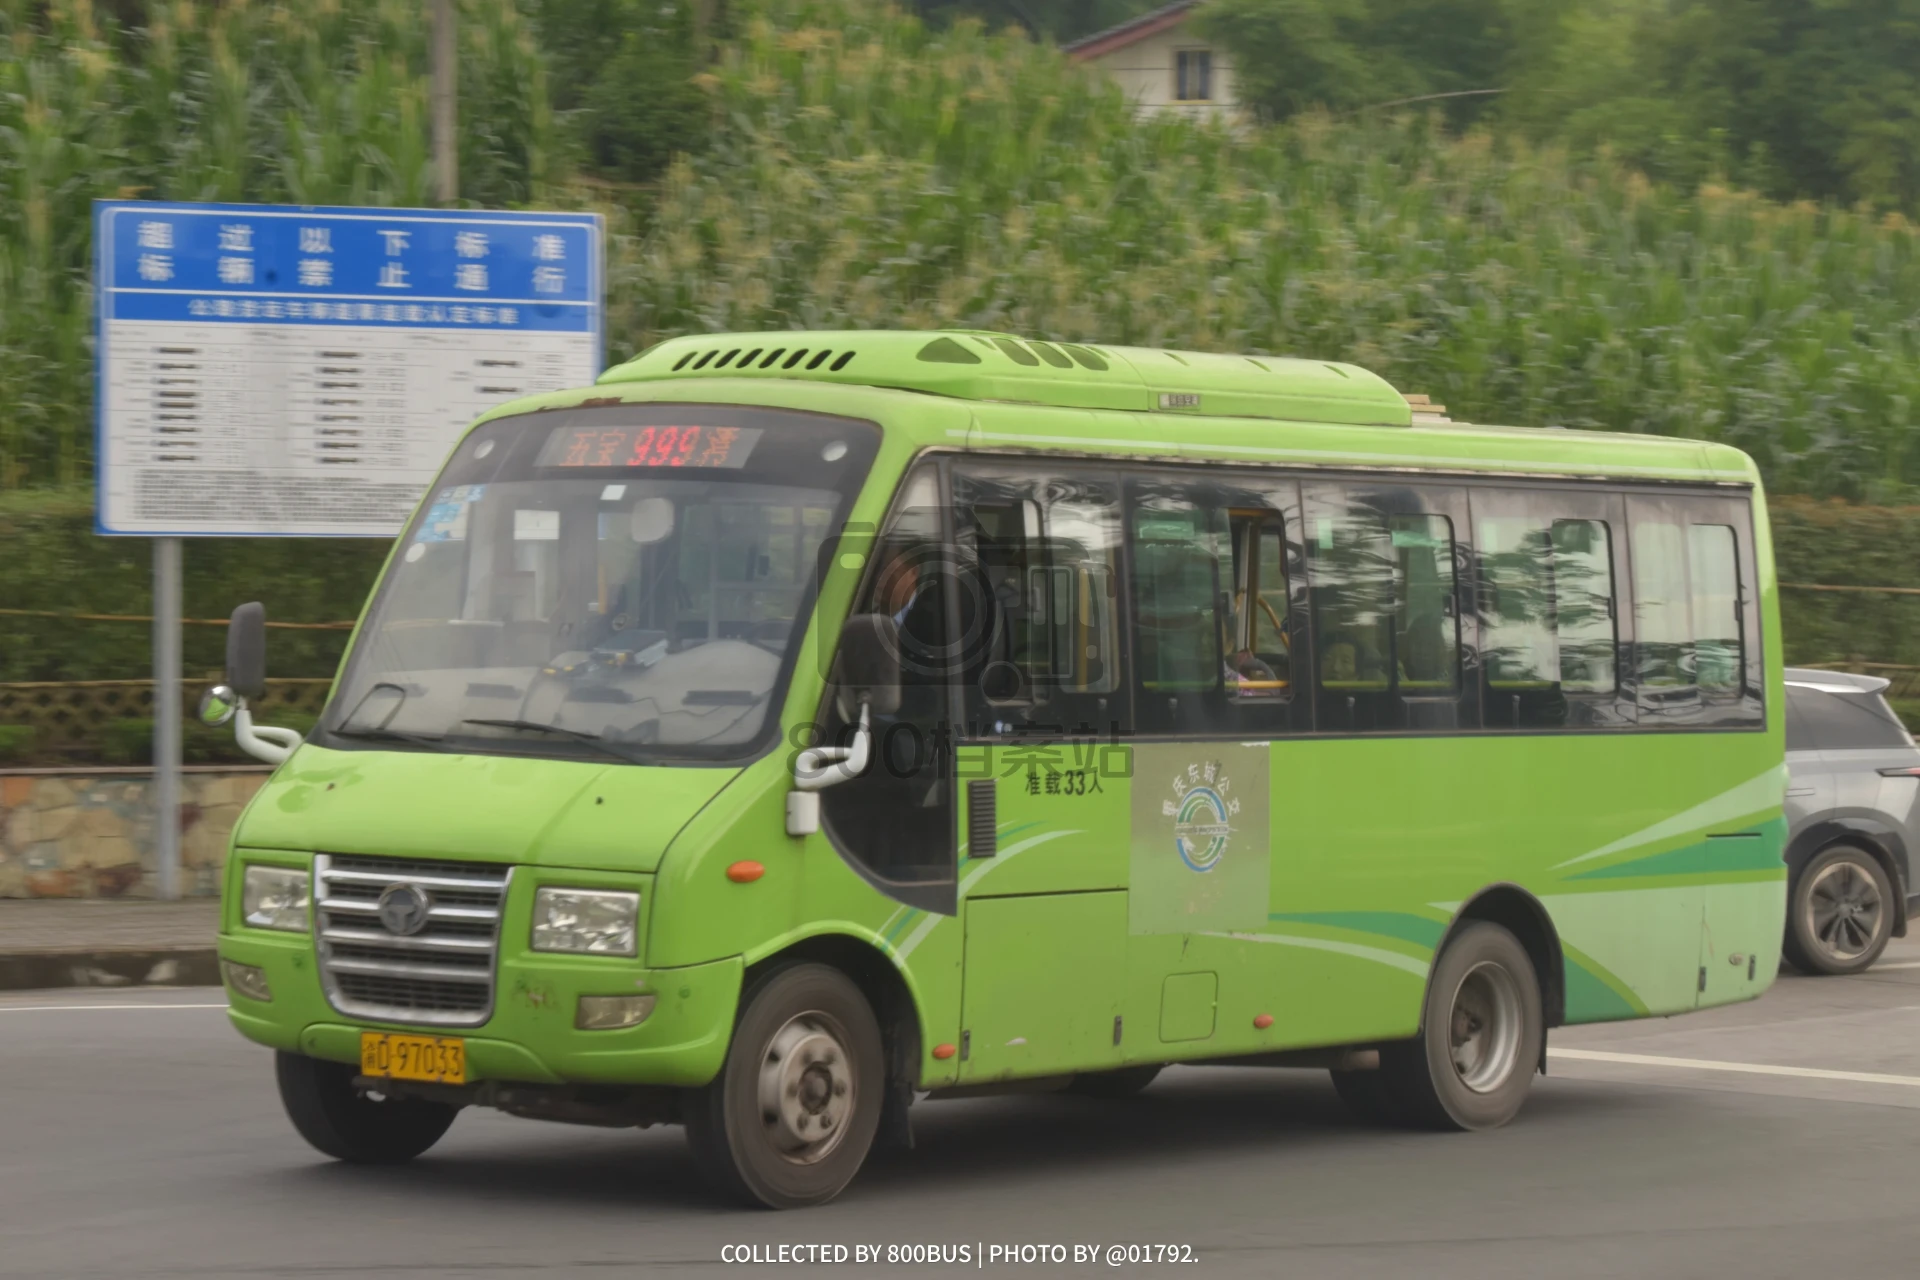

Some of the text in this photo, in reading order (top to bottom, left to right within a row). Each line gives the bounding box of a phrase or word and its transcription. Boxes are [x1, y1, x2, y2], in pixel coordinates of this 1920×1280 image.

[626, 426, 700, 467] 999
[1024, 769, 1104, 797] 准载33人
